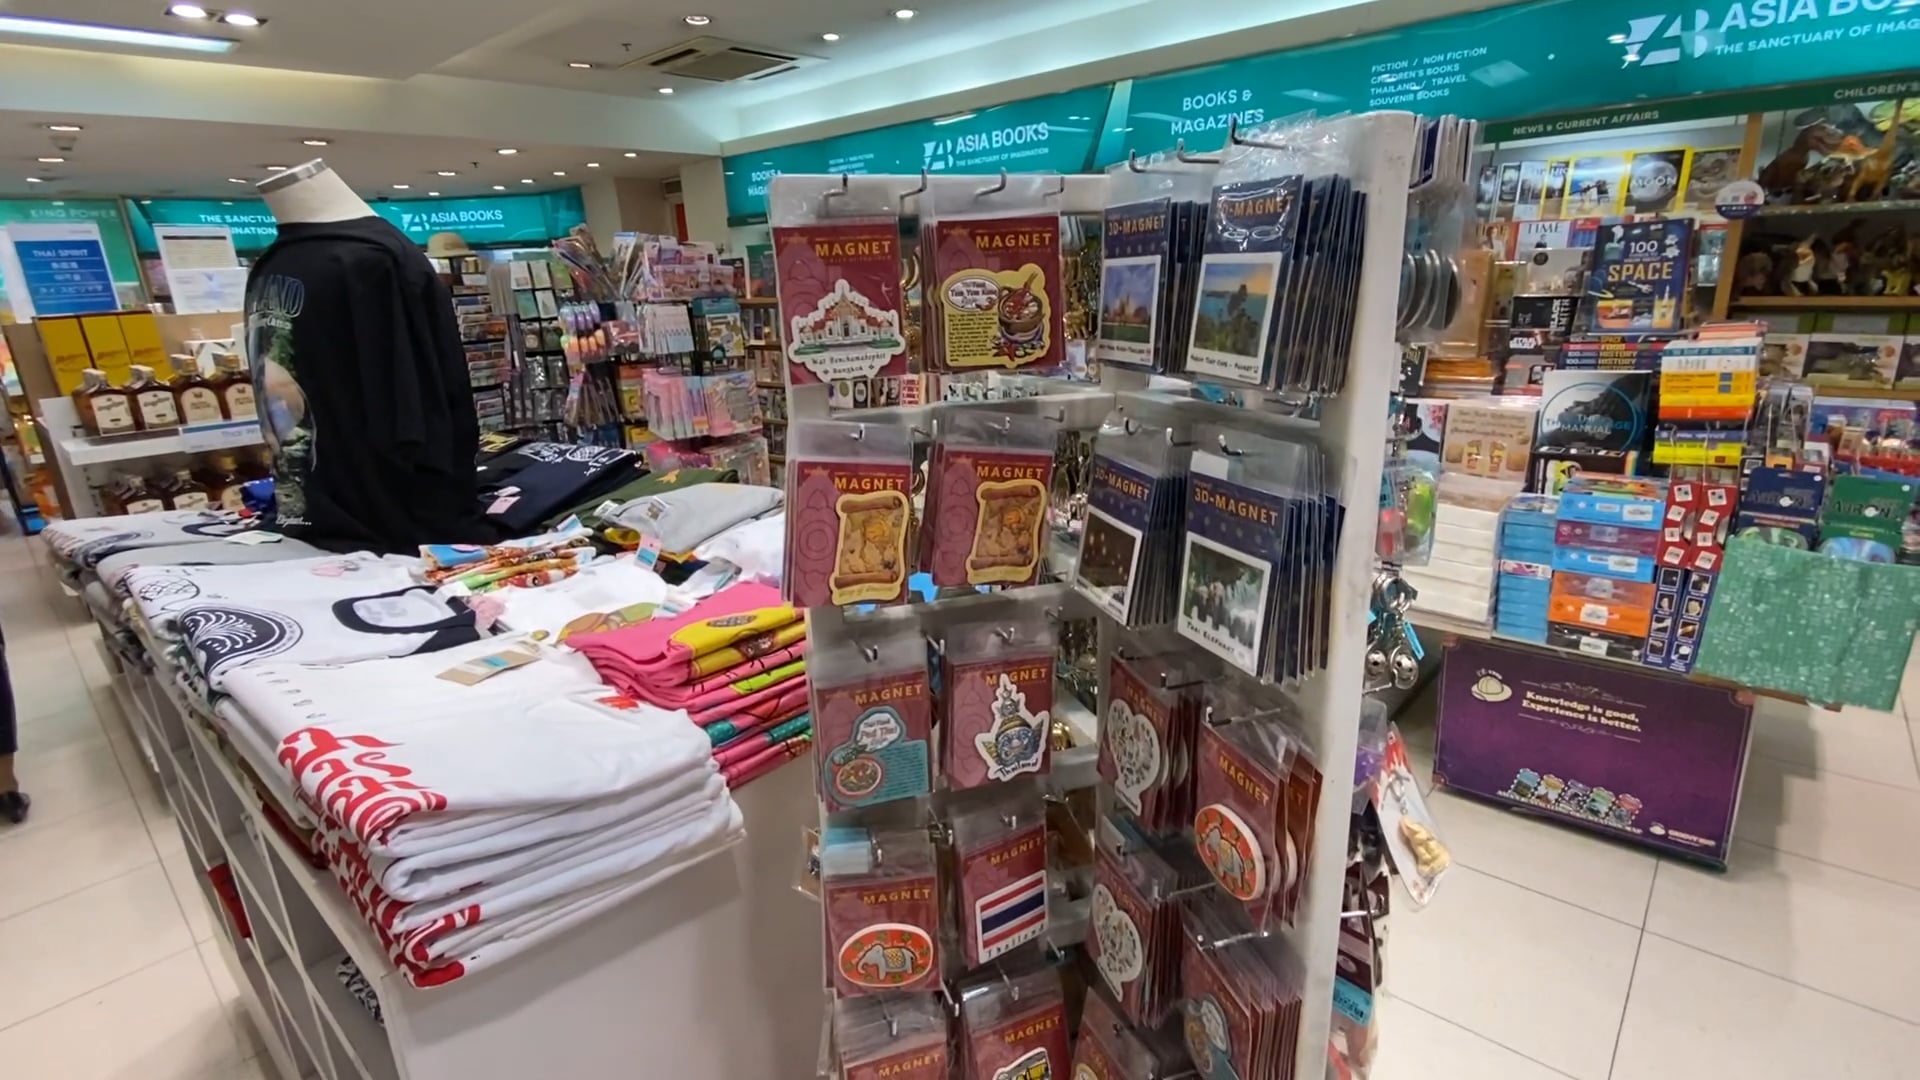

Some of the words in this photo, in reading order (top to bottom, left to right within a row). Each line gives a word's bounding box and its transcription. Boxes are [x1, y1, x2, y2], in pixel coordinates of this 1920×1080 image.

[1719, 0, 1819, 32] ASIA
[1714, 42, 1743, 56] THE
[1747, 27, 1844, 52] SANCTUARY
[1849, 23, 1872, 37] OF
[1876, 17, 1920, 34] IMAG
[1371, 60, 1409, 73] FICTION
[1423, 53, 1445, 65] NON
[1447, 46, 1488, 60] FICTION
[1426, 63, 1460, 76] BOOKS
[1370, 82, 1416, 95] THAILAND
[1431, 74, 1468, 86] TRAVEL
[1182, 90, 1238, 112] BOOKS
[1241, 89, 1253, 102] &
[1369, 93, 1414, 107] SOUVENIR
[1416, 88, 1450, 100] BOOKS
[1170, 108, 1264, 135] MAGAZINES
[1512, 124, 1544, 136] NEWS
[1556, 115, 1608, 131] CURRENT
[1611, 109, 1660, 124] AFFAIRS
[956, 133, 989, 155] ASIA
[992, 121, 1049, 148] BOOKS
[30, 208, 66, 218] KING
[69, 208, 117, 218] POWER
[430, 211, 459, 223] ASIA
[460, 209, 504, 222] BOOKS
[1222, 194, 1295, 218] D-MAGNET
[199, 214, 222, 223] THE
[224, 215, 277, 224] SANCTUA
[1526, 222, 1562, 235] TIME
[815, 240, 891, 257] MAGNET
[975, 233, 1052, 249] MAGNET
[1630, 240, 1658, 253] 100
[1607, 261, 1674, 282] SPACE
[1561, 423, 1613, 435] MANUAL
[833, 475, 904, 491] MAGNET
[976, 465, 1045, 480] MAGNET
[1093, 465, 1150, 501] 3D-MAGNET
[1193, 486, 1279, 527] 3D-MAGNET
[854, 683, 923, 706] MAGNET
[1526, 690, 1591, 713] Knowledge
[1592, 704, 1603, 715] is
[1521, 699, 1585, 721] Experience
[1587, 712, 1598, 723] is
[1600, 715, 1642, 733] better.
[1217, 755, 1270, 807] MAGNET
[990, 838, 1041, 866] MAGNET
[863, 888, 932, 906] MAGNET
[987, 923, 1045, 959] Thailand
[1005, 1015, 1062, 1045] MAGNET
[878, 1052, 941, 1078] MAGNET
